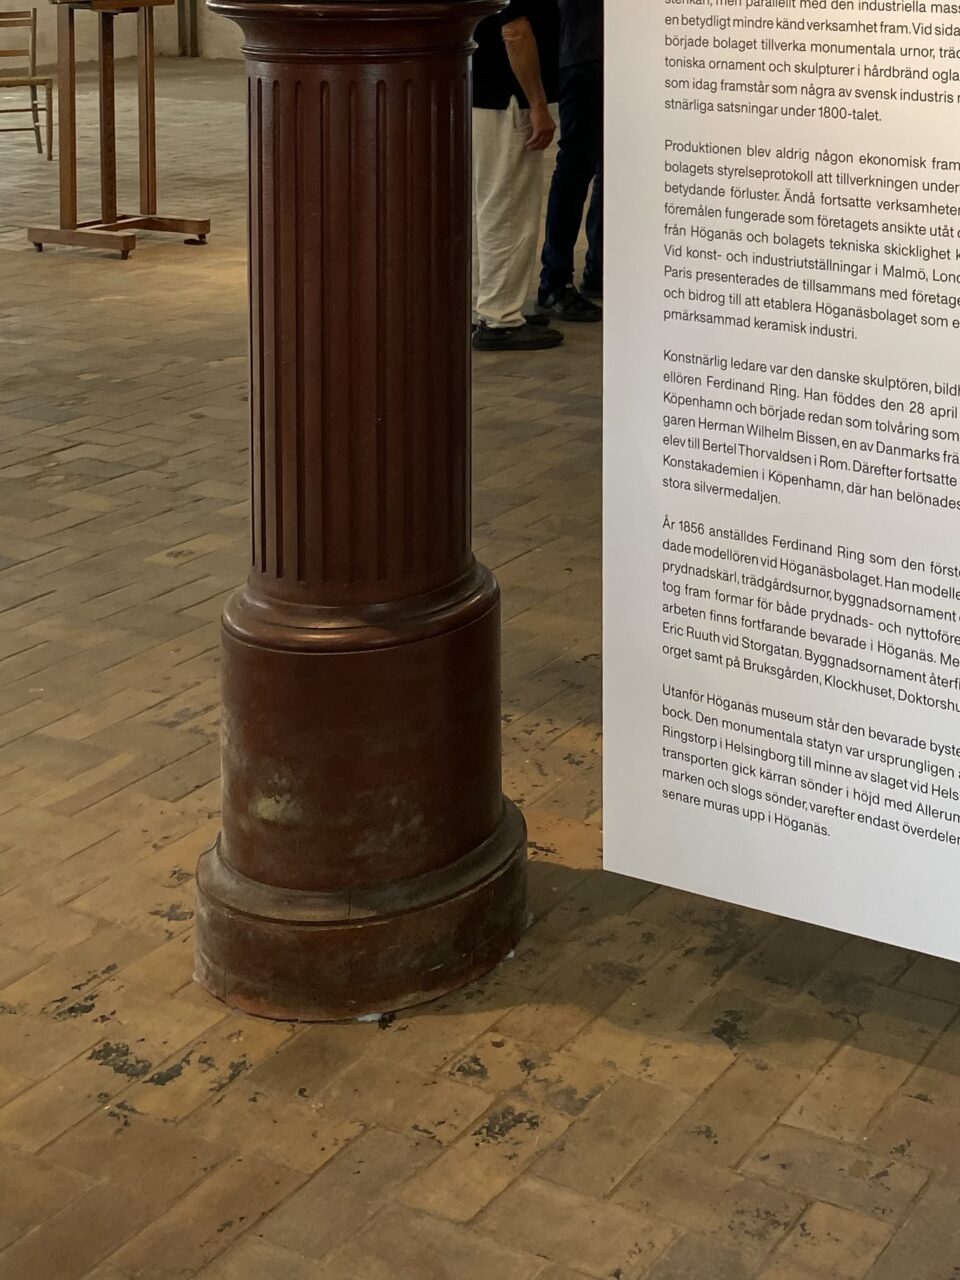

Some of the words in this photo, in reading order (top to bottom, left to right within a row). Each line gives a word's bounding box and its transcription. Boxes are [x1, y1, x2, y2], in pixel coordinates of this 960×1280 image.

[664, 138, 742, 156] Produktionen
[745, 143, 772, 158] blev
[774, 145, 810, 164] aldrig
[814, 148, 854, 166] någon
[858, 151, 927, 169] ekonomisk
[662, 370, 702, 386] ellören
[706, 374, 765, 394] Ferdinand
[769, 382, 800, 402] Ring.
[803, 386, 828, 402] Han
[832, 390, 876, 409] föddes
[879, 397, 905, 412] den
[908, 399, 925, 415] 28
[929, 405, 958, 420] april
[662, 414, 696, 428] garen
[697, 416, 745, 435] Herman
[745, 422, 794, 442] Wilhelm
[796, 429, 840, 450] Bissen,
[840, 438, 858, 451] en
[858, 440, 874, 453] av
[875, 439, 941, 463] Danmarks
[661, 537, 692, 554] dade
[692, 545, 759, 566] modellören
[759, 554, 778, 569] vid
[779, 556, 883, 588] Höganäsbolaget.
[884, 574, 910, 592] Han
[661, 644, 692, 660] orget
[693, 650, 723, 666] samt
[724, 655, 741, 670] på
[742, 656, 822, 687] Bruksgården,
[823, 673, 896, 702] Klockhuset,
[661, 703, 693, 722] bock.
[694, 710, 719, 728] Den
[721, 718, 804, 746] monumentala
[805, 736, 843, 755] statyn
[844, 745, 865, 758] var
[866, 749, 955, 778] ursprungligen
